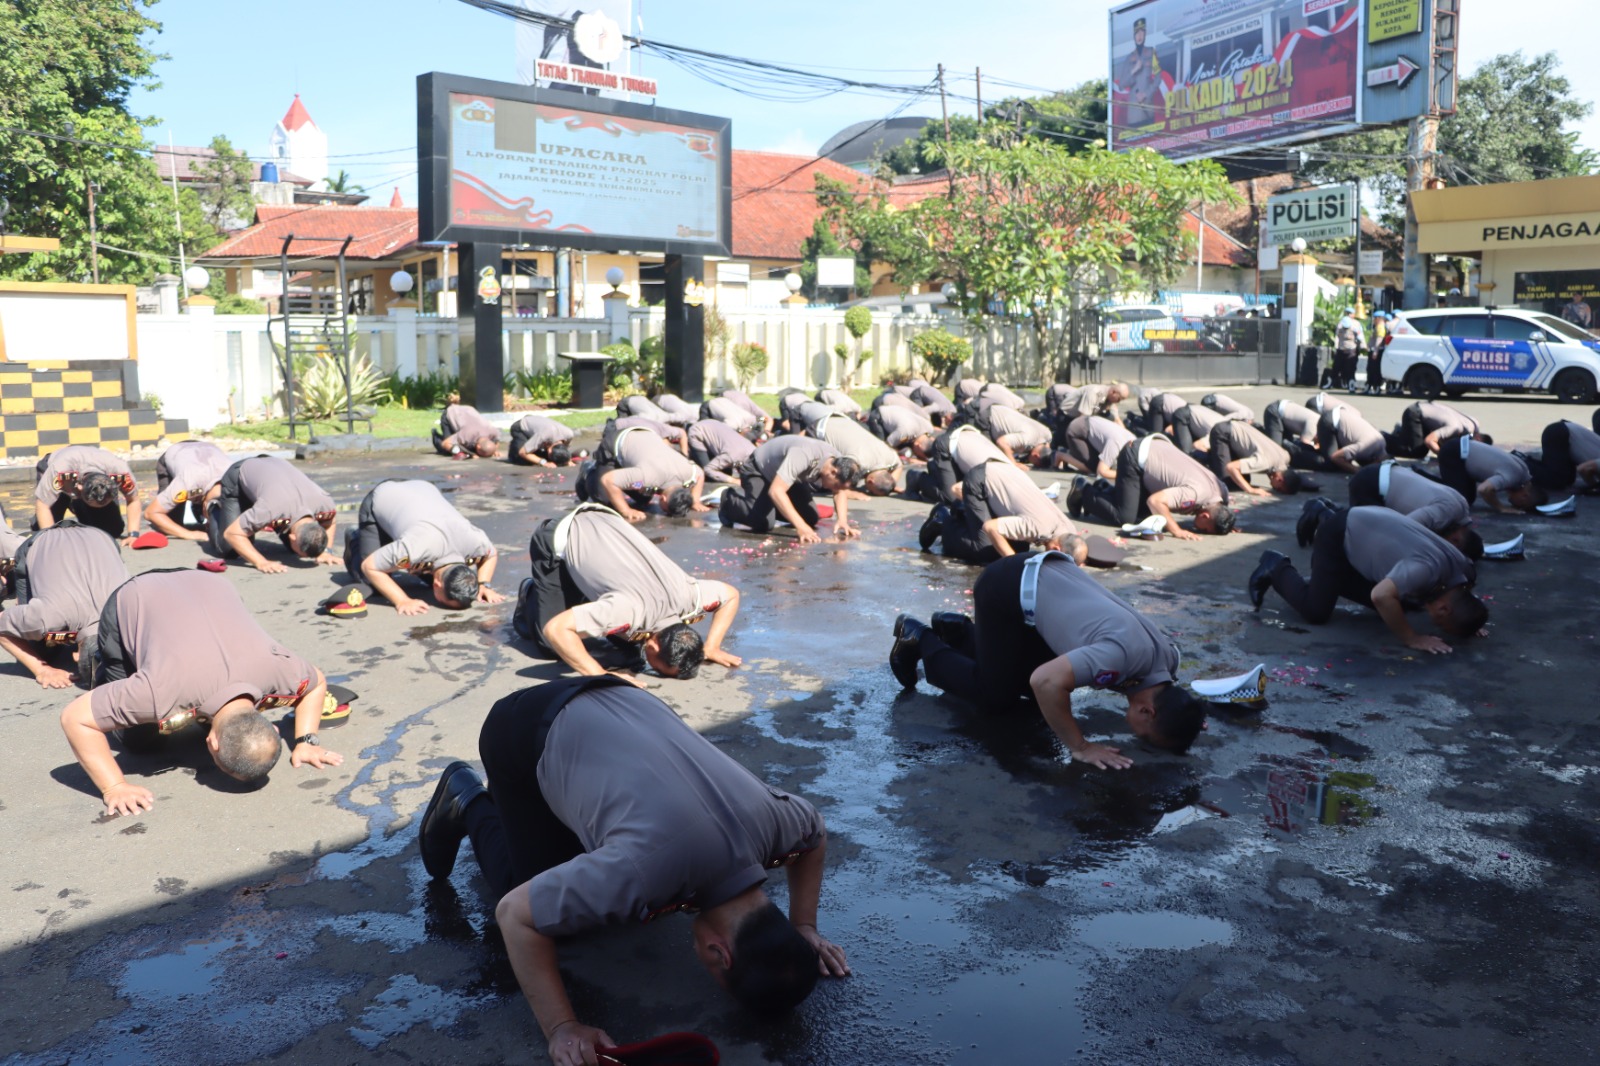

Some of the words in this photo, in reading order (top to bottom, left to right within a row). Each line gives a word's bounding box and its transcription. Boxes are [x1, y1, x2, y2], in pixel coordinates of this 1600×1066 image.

[1192, 34, 1213, 46] POLRES
[1215, 24, 1244, 39] SUKABUMI
[1246, 18, 1261, 29] KOTA
[1376, 14, 1411, 28] SUKABUMI
[1384, 25, 1402, 34] KOTA
[537, 62, 569, 81] TATAG
[621, 76, 657, 95] TUNGGA
[1165, 76, 1236, 118] PILKADA
[1241, 58, 1293, 100] 2024
[540, 143, 648, 166] UPACARA
[466, 150, 535, 163] LAPORAN
[538, 157, 608, 172] KENAIKAN
[610, 166, 667, 179] PANGKAT
[670, 173, 708, 183] POLRI
[529, 166, 597, 179] PERIODE
[600, 175, 657, 186] 1-1-2025
[499, 172, 549, 184] JAJARAN
[551, 178, 596, 188] POLRES
[598, 182, 653, 194] SUKABUMI
[1273, 193, 1345, 226] POLISI
[1273, 231, 1295, 241] POLRES
[1296, 228, 1327, 239] SUKABUMI
[1328, 226, 1344, 235] KOTA
[1463, 350, 1510, 364] POLISI
